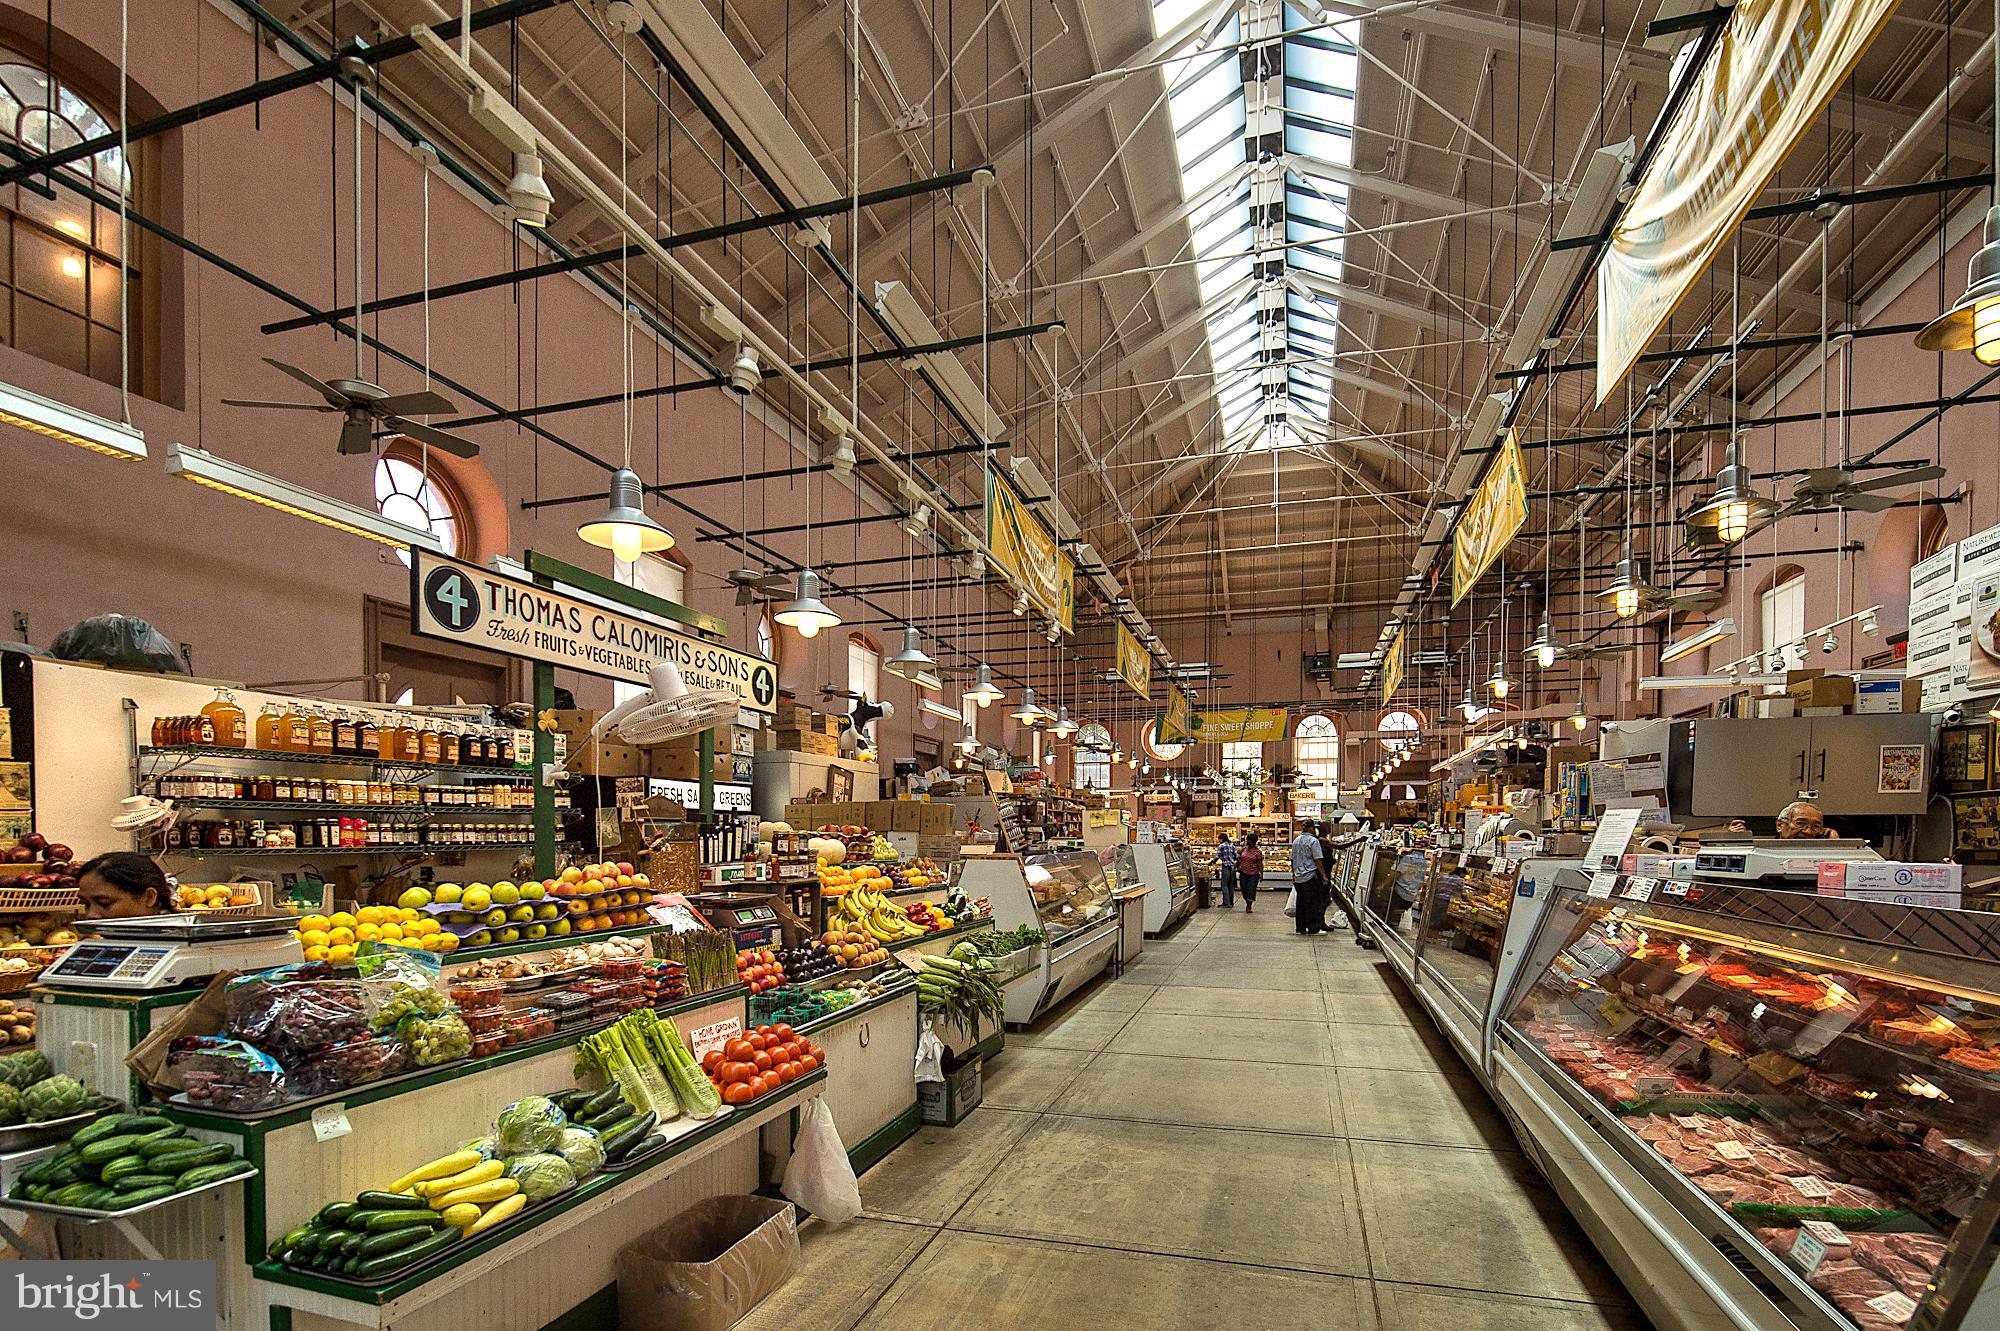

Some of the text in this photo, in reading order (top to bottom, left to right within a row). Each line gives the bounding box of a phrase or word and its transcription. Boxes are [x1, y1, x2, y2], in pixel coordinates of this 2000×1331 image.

[436, 575, 770, 703] 4 THOMAS CALOMIRIS & SON'S 4
[486, 619, 530, 645] Fresh
[535, 631, 577, 656] FRUITS
[585, 645, 650, 674] VEGETABLES
[1221, 722, 1244, 731] SWEET
[1246, 721, 1274, 730] SHOPPE
[720, 792, 751, 806] GREENS
